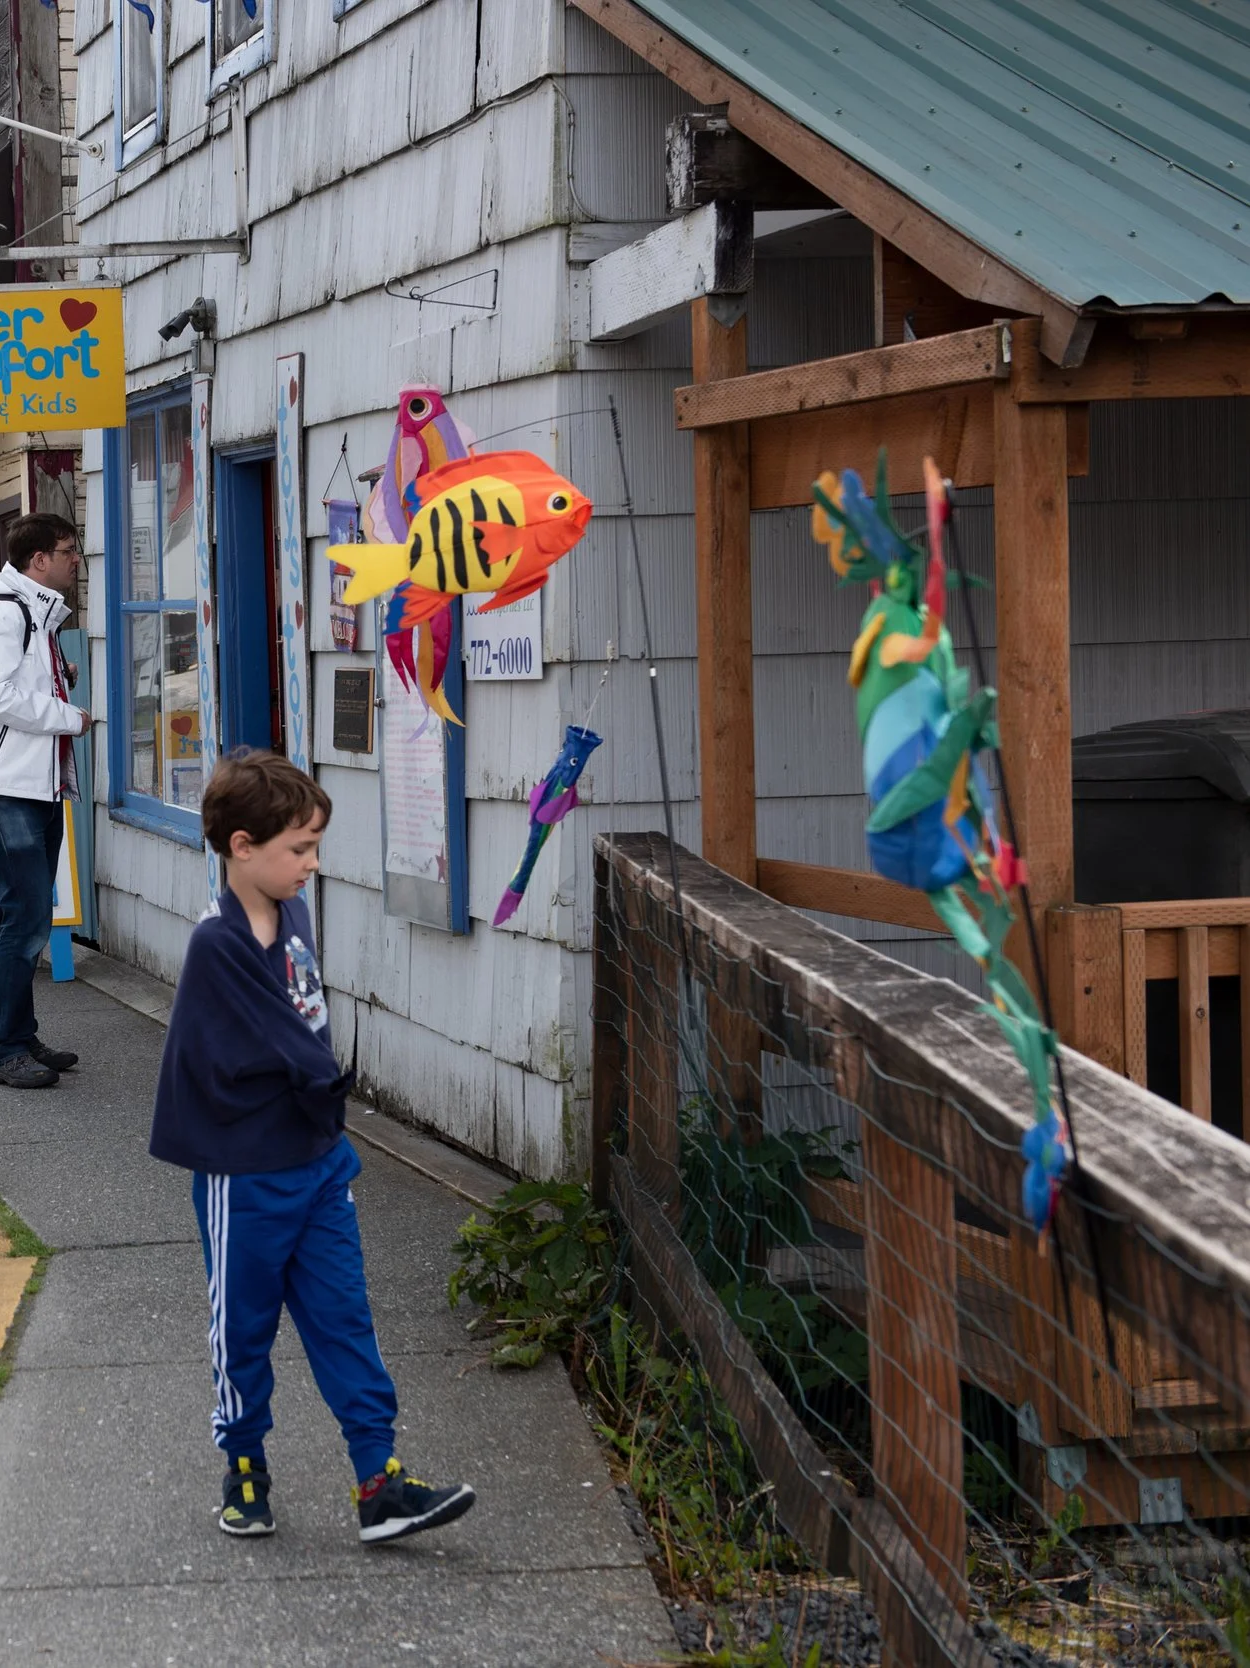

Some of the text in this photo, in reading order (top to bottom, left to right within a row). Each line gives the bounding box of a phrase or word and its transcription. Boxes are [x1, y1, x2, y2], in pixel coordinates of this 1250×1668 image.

[20, 392, 77, 416] Kids
[278, 385, 299, 588] toys
[36, 592, 51, 604] HH
[471, 636, 532, 675] 772-6000
